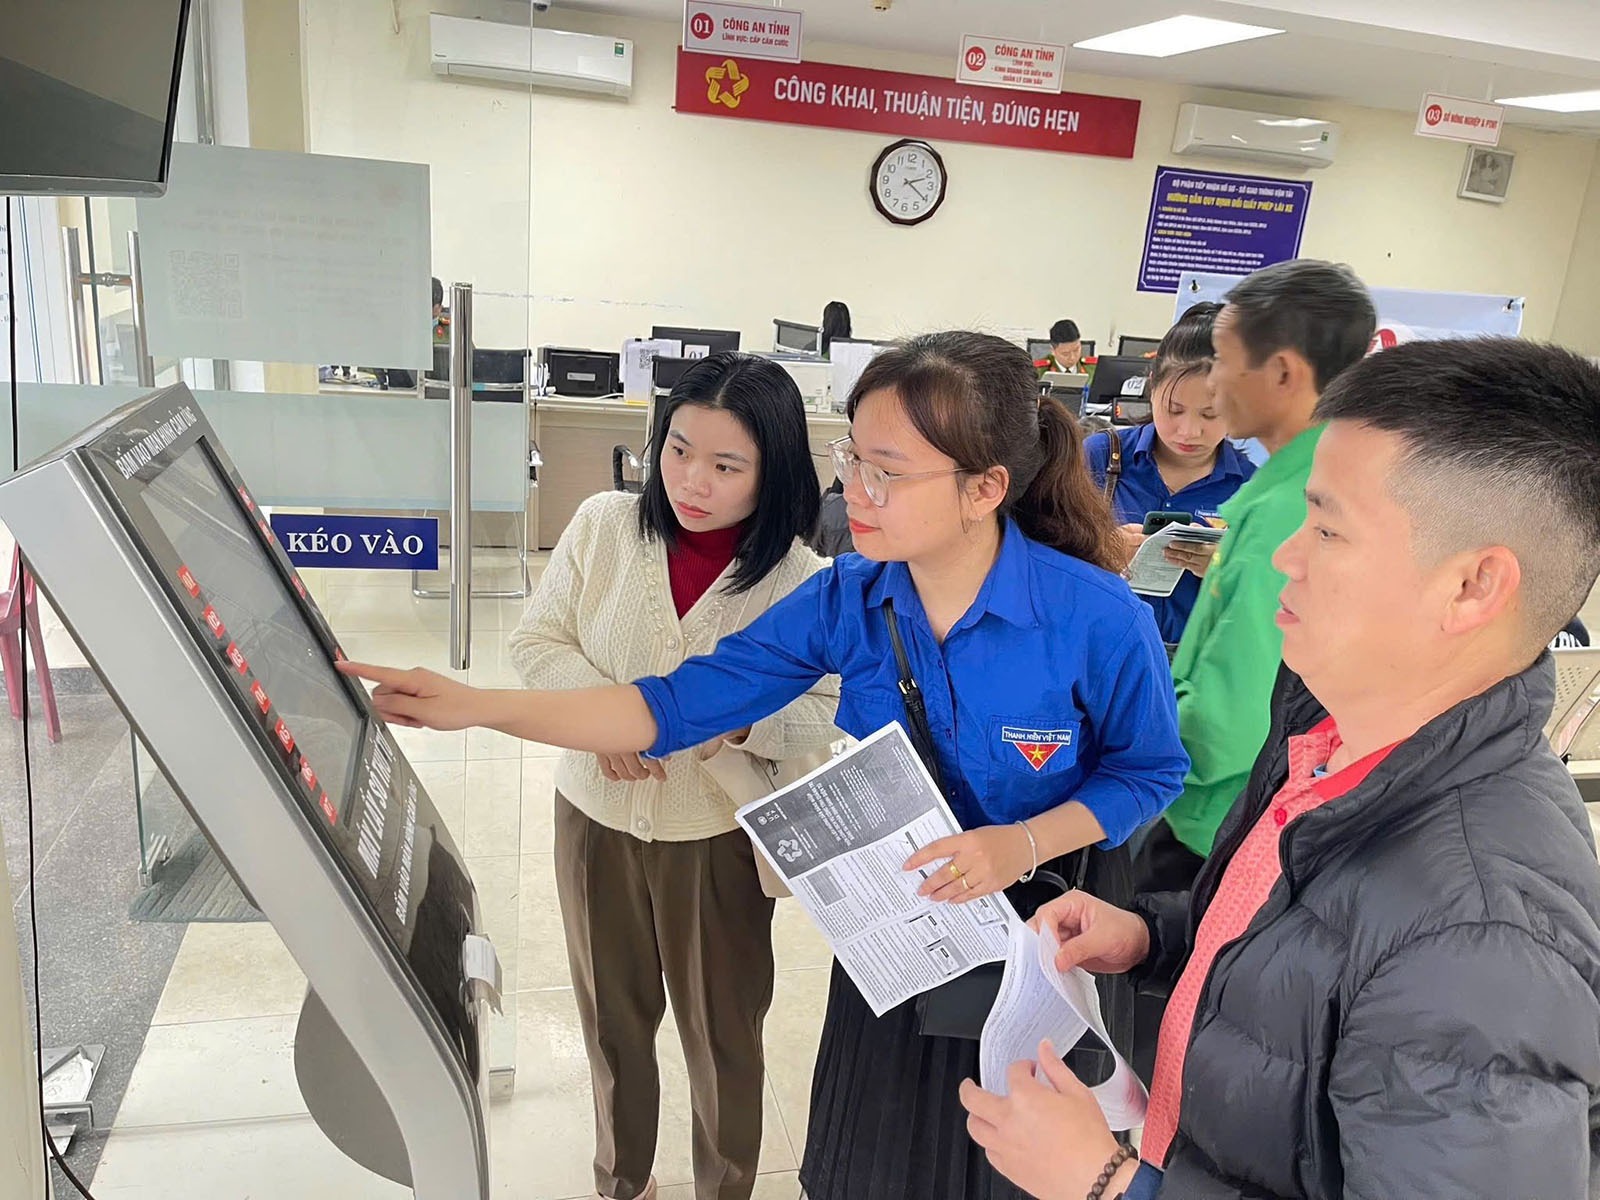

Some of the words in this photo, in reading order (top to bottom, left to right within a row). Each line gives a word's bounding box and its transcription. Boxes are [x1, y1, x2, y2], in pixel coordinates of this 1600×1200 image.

[694, 18, 710, 34] 01
[722, 17, 749, 31] CÔNG
[752, 22, 765, 33] AN
[769, 21, 790, 36] TỈNH
[968, 52, 984, 66] 02
[995, 44, 1018, 57] CÔNG
[1021, 49, 1033, 59] AN
[1036, 47, 1055, 62] TỈNH
[774, 75, 826, 104] CÔNG
[831, 84, 878, 114] KHAI,
[884, 89, 942, 120] THUẬN
[946, 95, 986, 126] TIỆN,
[992, 100, 1040, 128] ĐÚNG
[1044, 109, 1080, 135] HẸN
[1427, 108, 1440, 121] 03
[908, 153, 917, 163] 12
[887, 164, 896, 174] 10
[926, 169, 933, 178] 2
[882, 175, 889, 184] 9
[884, 188, 891, 198] 8
[927, 182, 933, 191] 3
[893, 198, 899, 207] 7
[901, 203, 908, 212] 6
[913, 201, 919, 210] 5
[115, 446, 140, 480] BẤM
[129, 438, 152, 467] VÀO
[286, 527, 352, 553] KÉO
[360, 529, 424, 555] VÀO
[1004, 731, 1025, 740] THANH
[364, 758, 387, 809] SỐ
[360, 787, 385, 840] LẤY
[356, 822, 381, 879] MÁY
